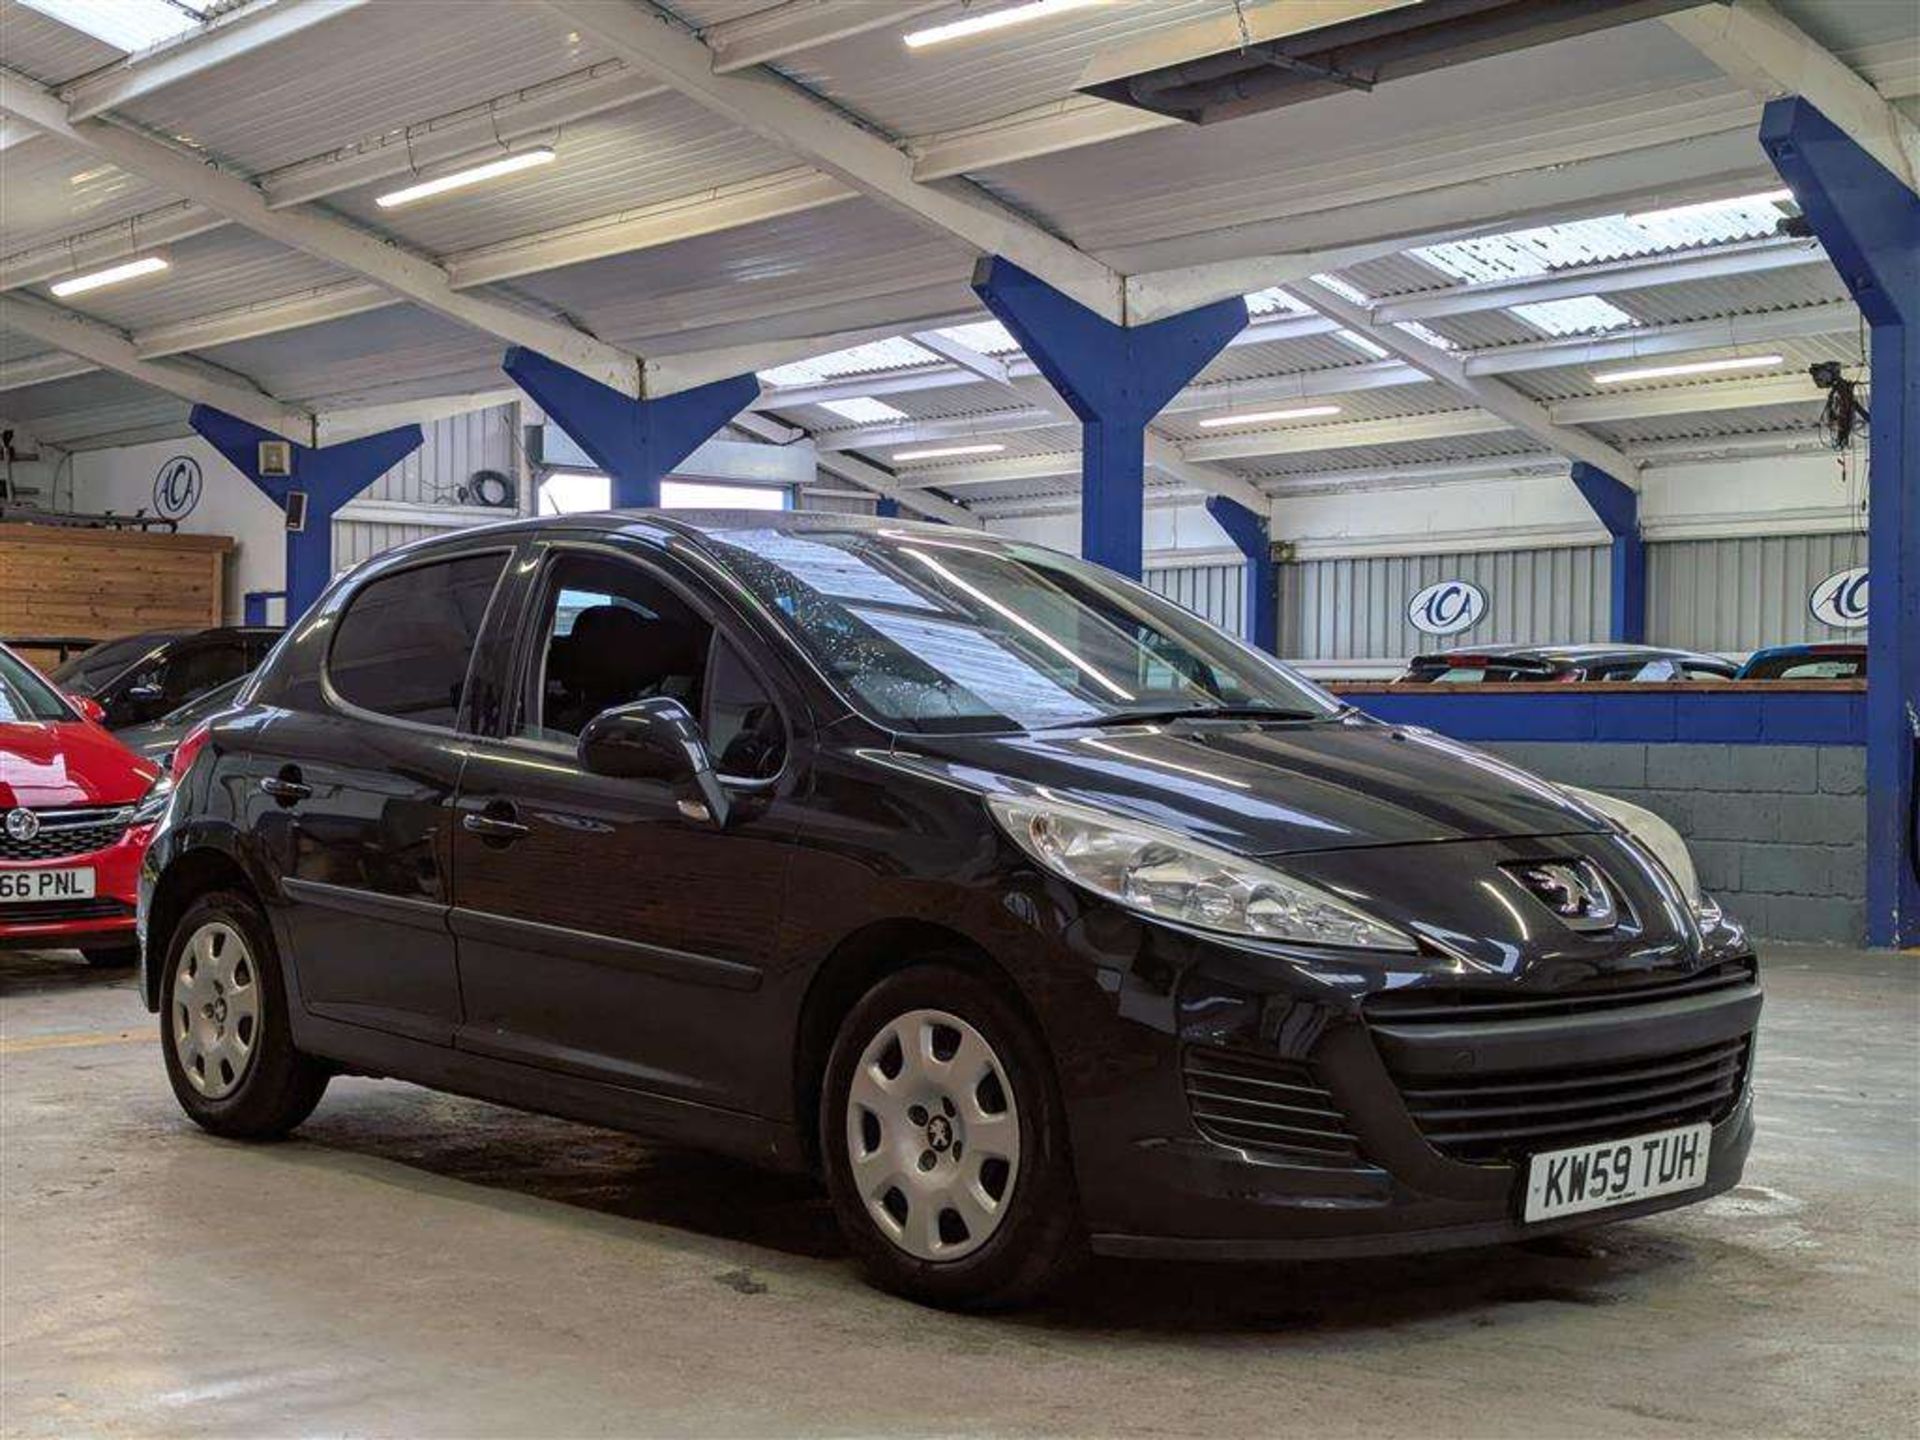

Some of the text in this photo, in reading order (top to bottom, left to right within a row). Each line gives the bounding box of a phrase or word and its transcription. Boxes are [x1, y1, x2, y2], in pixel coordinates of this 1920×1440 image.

[1412, 586, 1472, 627] ACA
[1816, 573, 1868, 619] AC
[0, 871, 84, 897] 66 PNL
[1544, 1132, 1699, 1208] KW59 TUH
